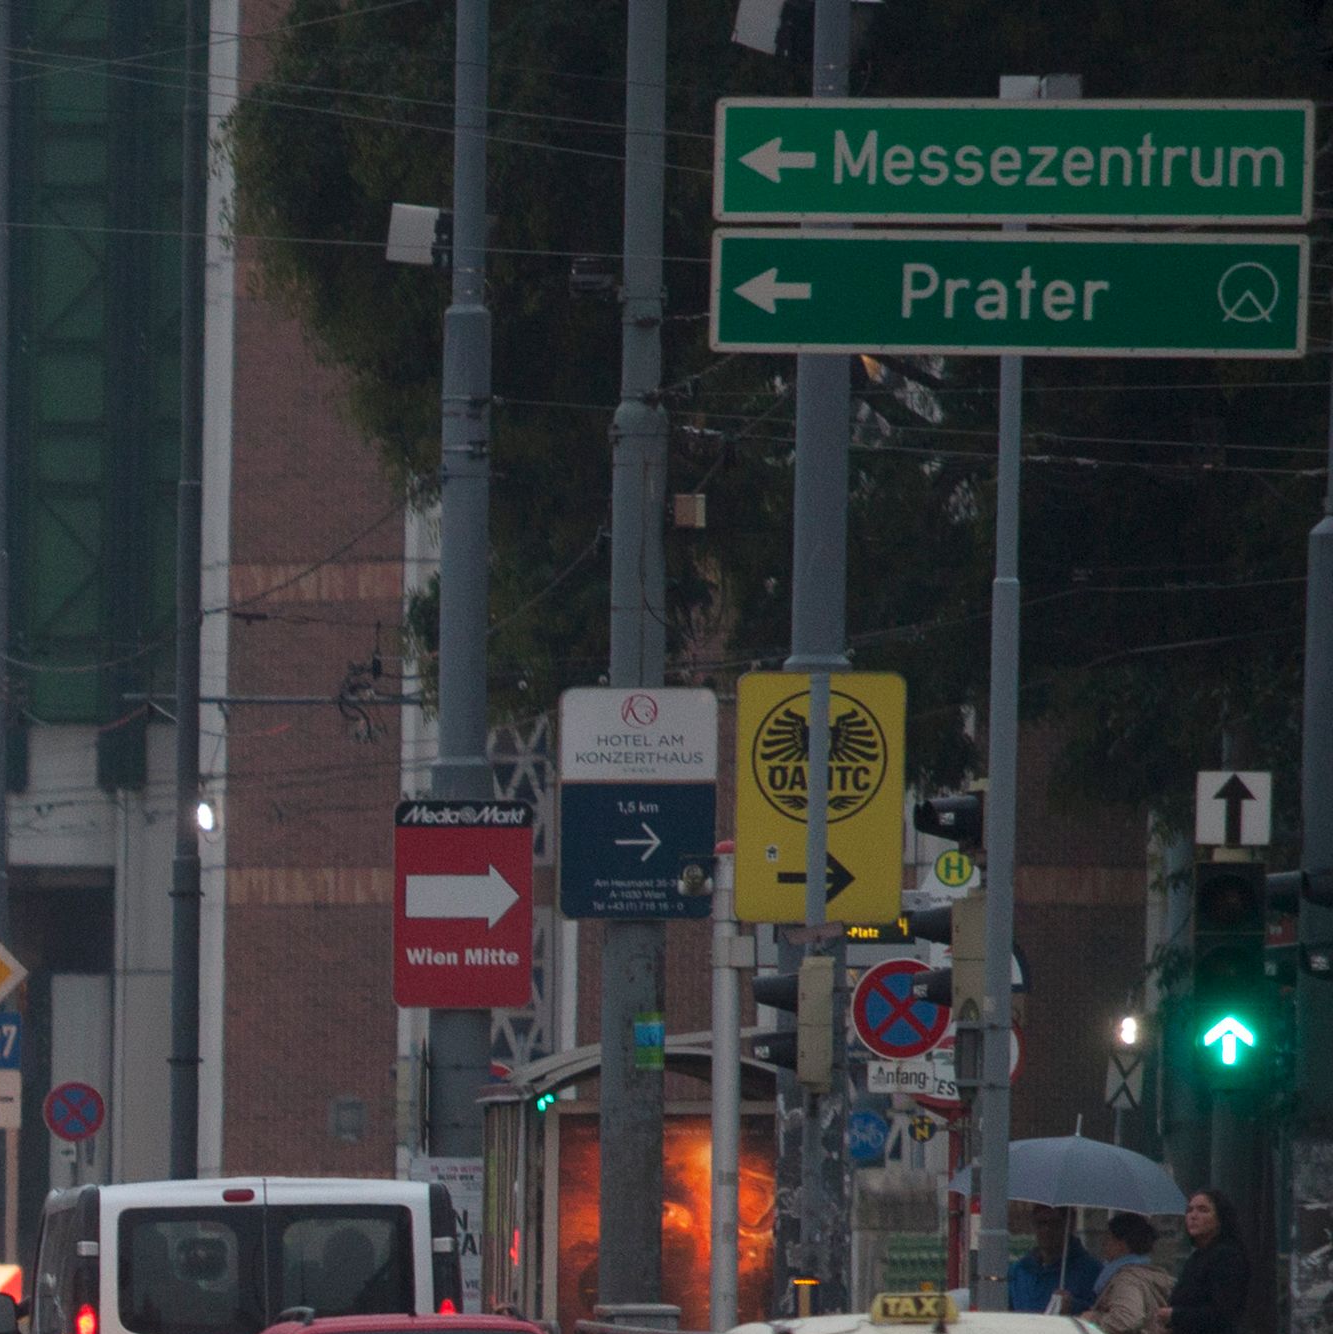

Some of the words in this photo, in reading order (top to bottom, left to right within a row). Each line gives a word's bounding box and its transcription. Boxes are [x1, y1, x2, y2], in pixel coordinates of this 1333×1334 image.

[834, 129, 1285, 188] Messezentrum
[901, 262, 1109, 321] Prater
[597, 734, 652, 748] HOTEL
[658, 734, 684, 748] AM
[575, 751, 704, 765] KONZERTHAUS
[768, 764, 870, 792] ÖATC
[639, 801, 659, 813] km
[944, 857, 965, 879] H
[406, 948, 458, 966] Wien
[465, 948, 520, 966] Mitte
